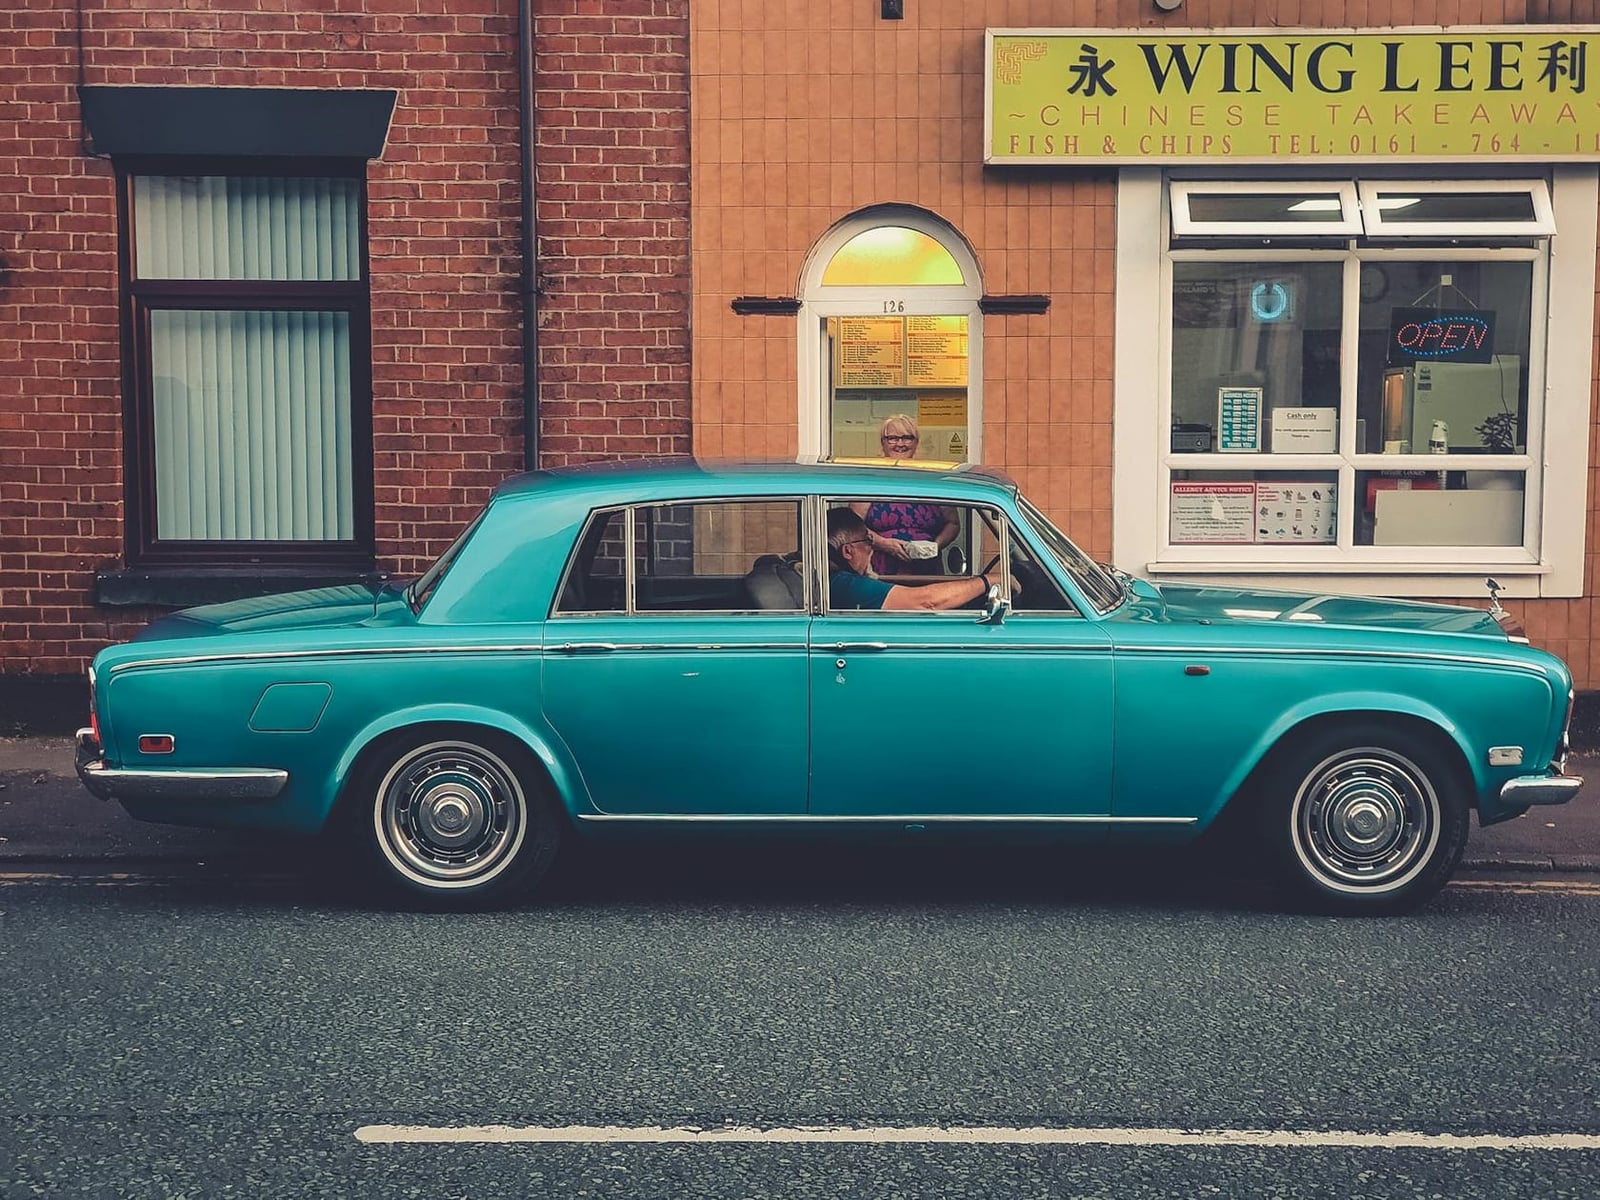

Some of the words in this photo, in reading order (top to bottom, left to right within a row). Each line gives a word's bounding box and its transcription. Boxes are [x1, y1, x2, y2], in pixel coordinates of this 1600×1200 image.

[1067, 44, 1118, 96] 永
[1137, 42, 1357, 95] WING
[1379, 41, 1524, 92] LEE
[1537, 40, 1588, 94] 利
[1326, 102, 1600, 125] TAKEAWA
[1009, 135, 1079, 154] FISH
[1102, 136, 1117, 154] &
[1139, 134, 1232, 154] CHIPS
[1471, 133, 1520, 153] 764
[883, 300, 905, 313] 126
[1398, 323, 1488, 350] OPEN
[1287, 412, 1301, 420] Cash
[1302, 412, 1318, 420] only
